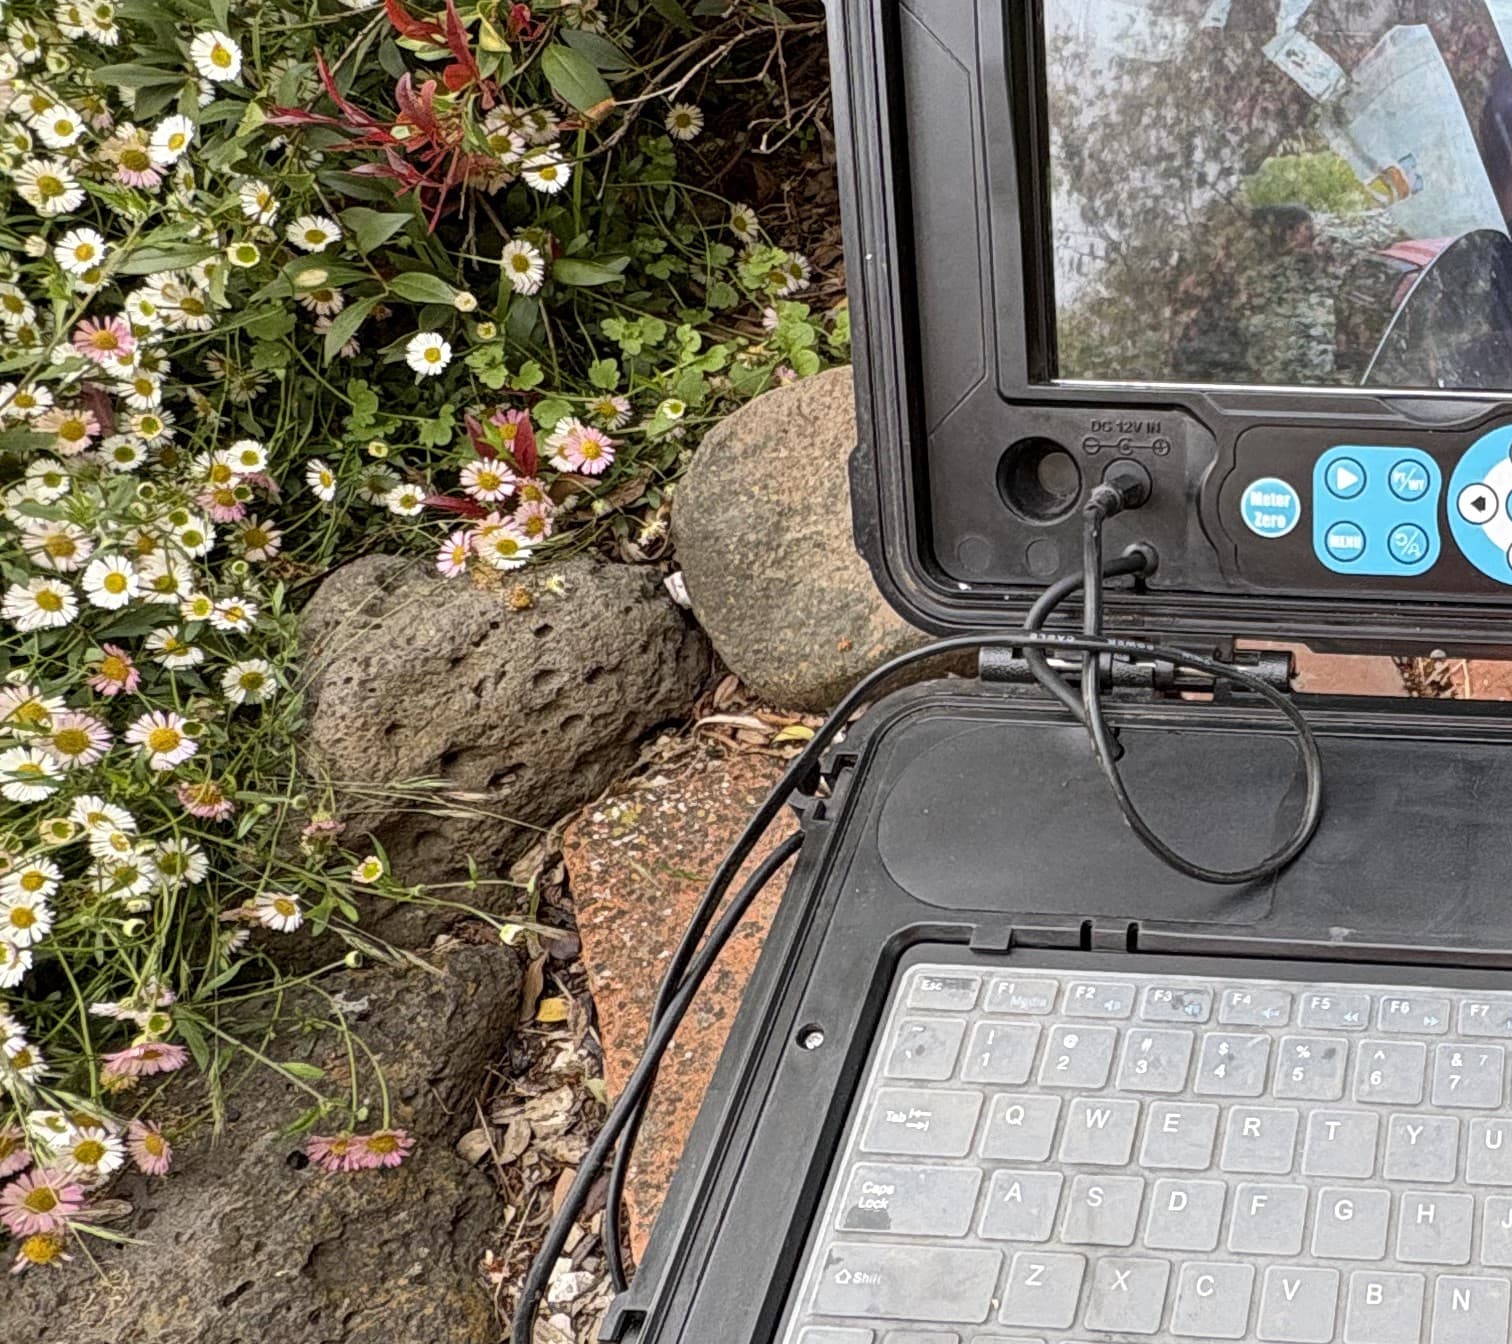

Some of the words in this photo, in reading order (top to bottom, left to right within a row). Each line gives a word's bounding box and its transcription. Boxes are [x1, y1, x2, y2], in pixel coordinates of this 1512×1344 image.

[1116, 420, 1143, 434] 12V
[1250, 491, 1291, 508] Meter
[1254, 511, 1287, 529] Zero
[921, 980, 942, 991] Esc
[998, 982, 1014, 995] F1
[1076, 986, 1096, 999] F2
[1154, 989, 1173, 1002] F3
[1233, 993, 1251, 1005] F4
[1311, 997, 1331, 1010] F5
[1391, 1000, 1410, 1013] F6
[1470, 1004, 1489, 1017] F7
[987, 1030, 995, 1045] !
[1063, 1035, 1079, 1049] @
[1141, 1038, 1152, 1051] #
[1218, 1042, 1229, 1056] $
[1296, 1045, 1311, 1058] %
[982, 1052, 991, 1067] 1
[1057, 1057, 1070, 1070] 2
[1136, 1060, 1147, 1074] 3
[1451, 1053, 1464, 1067] &
[1478, 1054, 1489, 1066] 7
[1214, 1064, 1226, 1078] 4
[1292, 1067, 1304, 1082] 5
[1370, 1071, 1382, 1085] 6
[1450, 1075, 1461, 1091] 7
[886, 1110, 906, 1123] Tab
[1005, 1105, 1026, 1126] Q
[1086, 1109, 1112, 1129] W
[1163, 1113, 1181, 1132] E
[1241, 1117, 1261, 1137] R
[1325, 1121, 1342, 1141] T
[1406, 1125, 1424, 1144] Y
[1485, 1130, 1503, 1149] U
[862, 1181, 895, 1196] Caps
[1004, 1182, 1023, 1202] A
[858, 1197, 889, 1210] Lock
[1087, 1187, 1104, 1207] S
[1168, 1191, 1187, 1211] D
[1250, 1195, 1267, 1216] F
[1334, 1199, 1353, 1221] G
[1416, 1203, 1435, 1224] H
[1024, 1265, 1046, 1286] Z
[1111, 1270, 1131, 1291] X
[1196, 1275, 1215, 1296] C
[1282, 1279, 1301, 1301] V
[1366, 1284, 1383, 1305] B
[1452, 1289, 1470, 1311] N
